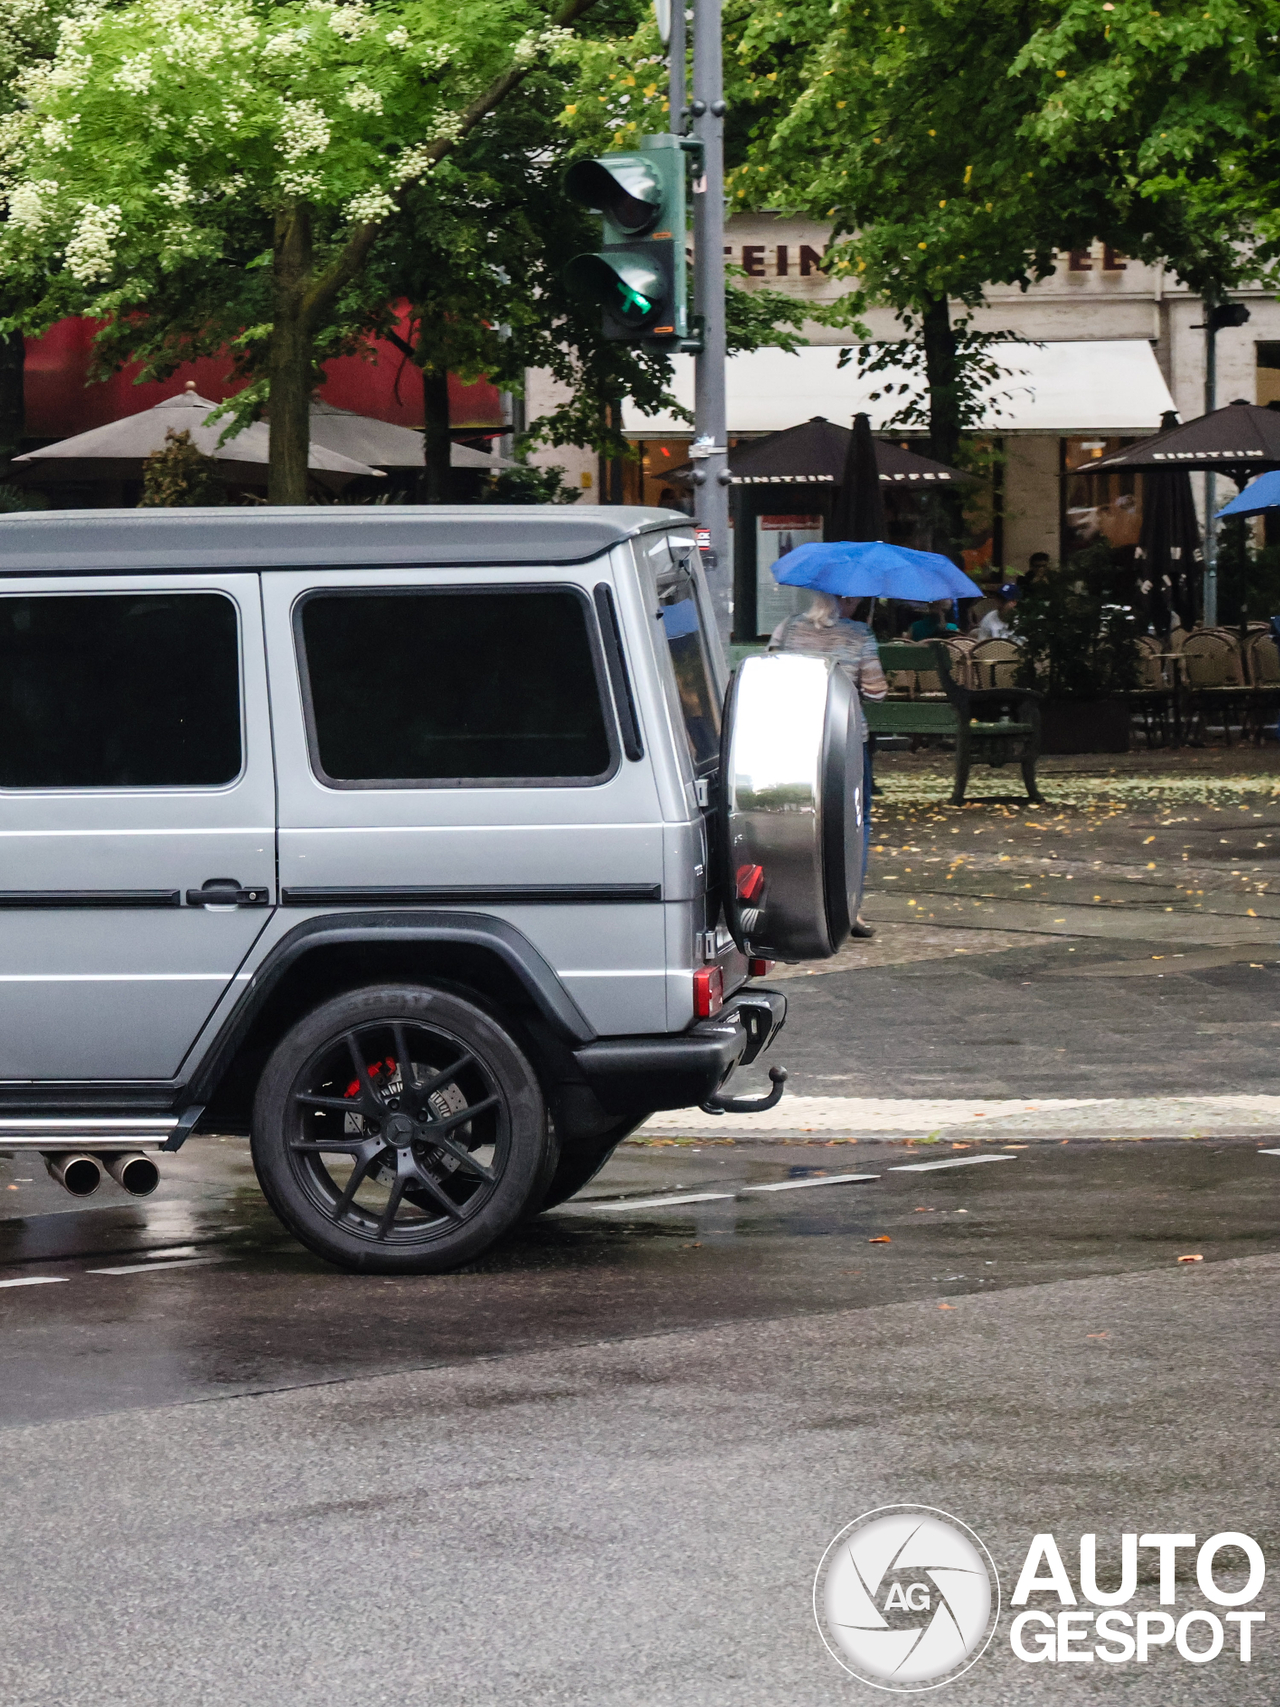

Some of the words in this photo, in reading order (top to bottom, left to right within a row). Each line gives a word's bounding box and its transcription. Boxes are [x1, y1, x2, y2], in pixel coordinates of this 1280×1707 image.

[1152, 450, 1265, 461] EINSTEIN
[730, 474, 834, 484] EINSTEIN
[878, 472, 951, 481] AFFEE
